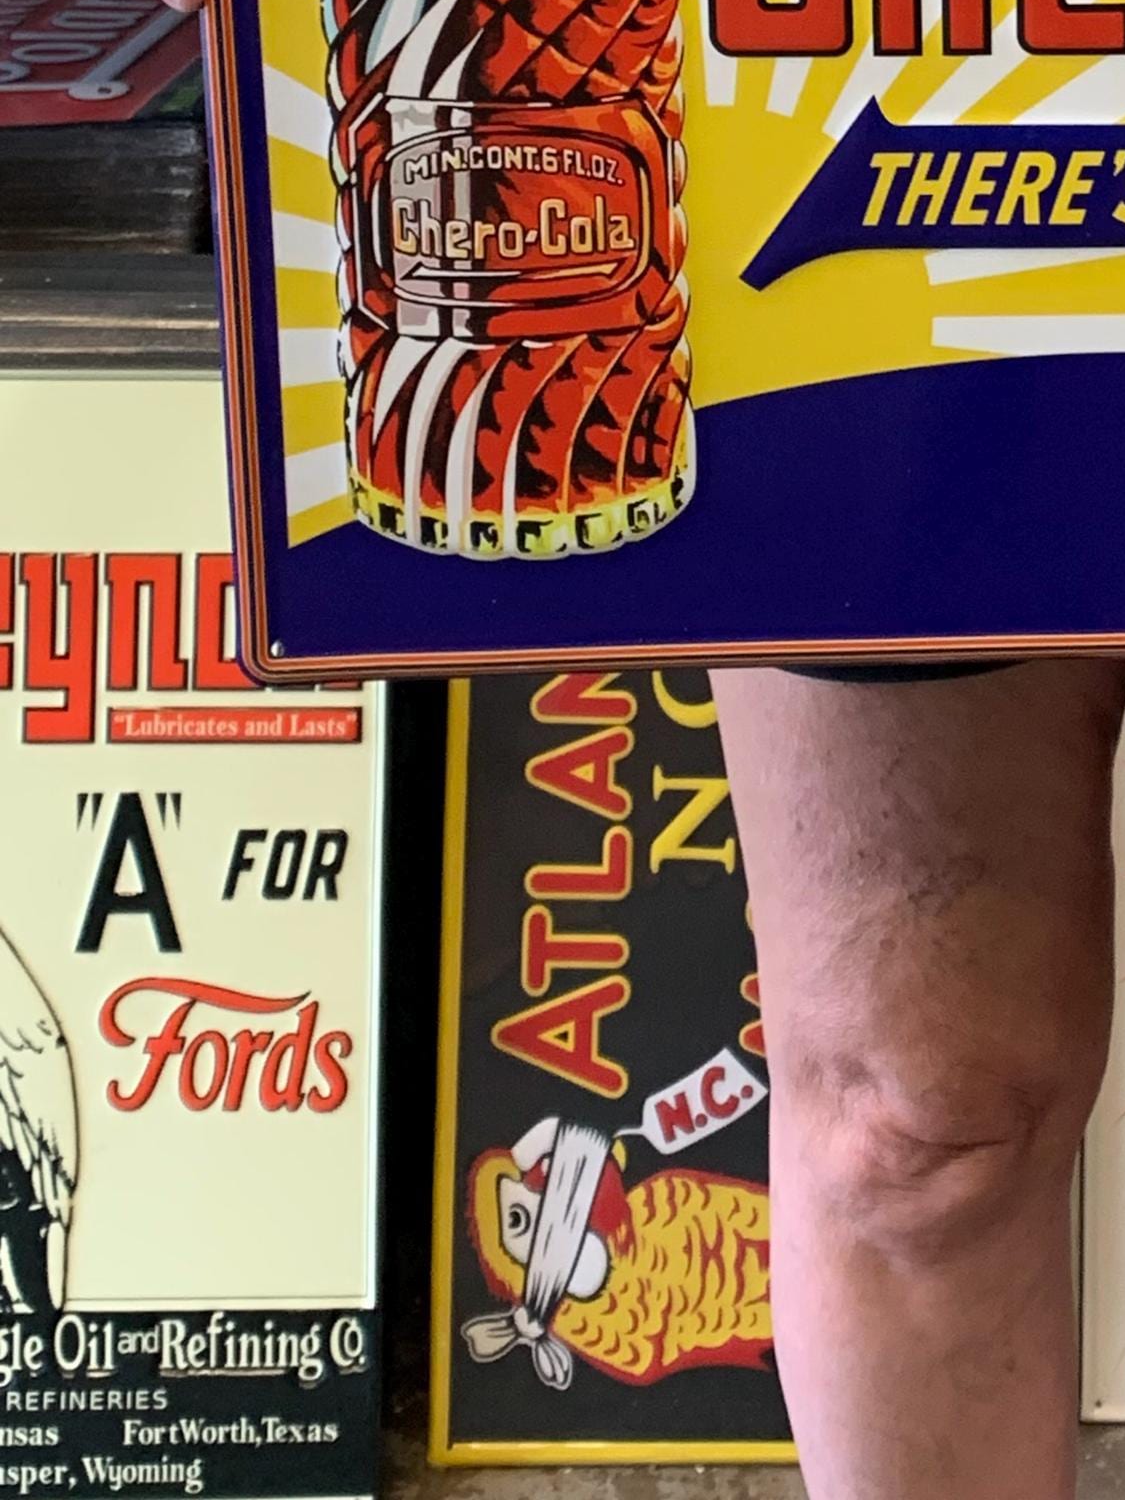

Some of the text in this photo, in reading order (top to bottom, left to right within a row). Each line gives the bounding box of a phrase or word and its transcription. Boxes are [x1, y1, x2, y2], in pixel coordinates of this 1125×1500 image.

[469, 145, 541, 172] CONT.
[541, 146, 559, 173] 6
[393, 195, 635, 261] Chero-Cola
[244, 713, 284, 738] and
[75, 792, 349, 953] "A" FOR
[99, 977, 353, 1113] Fords
[653, 1065, 757, 1145] N.C.
[54, 1314, 115, 1371] Oil
[117, 1327, 161, 1354] and
[160, 1311, 325, 1382] Refining
[6, 1390, 169, 1412] REFINERIES
[81, 1454, 204, 1494] Wyoming
